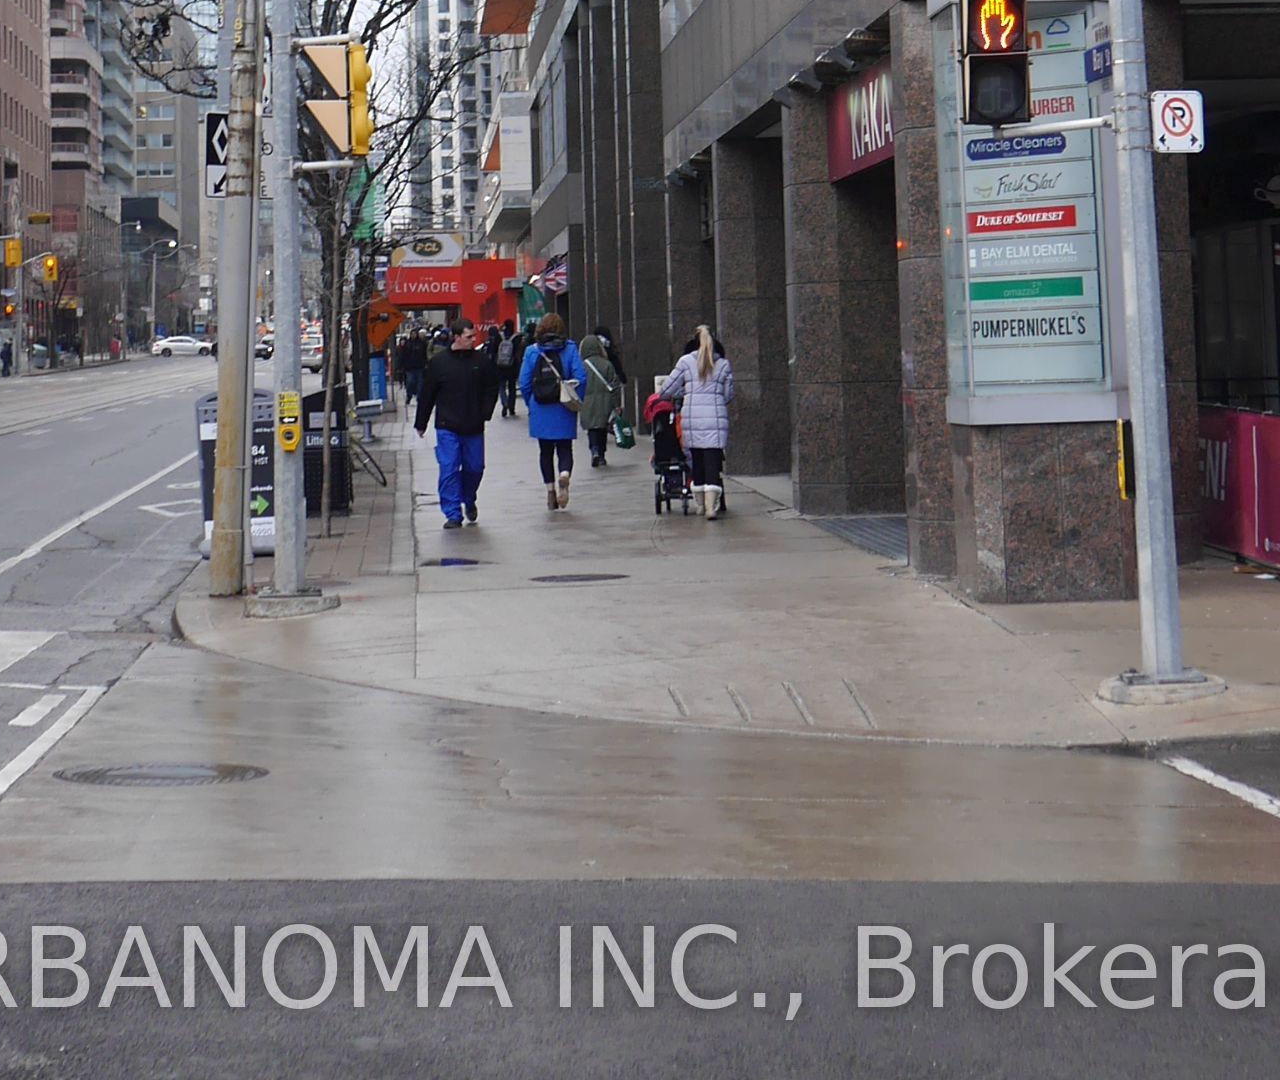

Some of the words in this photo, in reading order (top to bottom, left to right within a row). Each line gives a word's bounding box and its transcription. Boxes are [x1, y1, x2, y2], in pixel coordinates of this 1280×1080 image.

[1031, 95, 1075, 117] URGER
[850, 73, 893, 160] KAKA
[970, 137, 1010, 153] Miracle
[1012, 134, 1062, 151] Cleaners
[976, 213, 1003, 227] DUKE
[1003, 214, 1015, 225] OF
[1015, 210, 1065, 224] SOMERSET
[415, 242, 439, 252] PCL
[980, 247, 1003, 260] BAY
[1006, 245, 1030, 259] ELM
[1032, 243, 1077, 257] DENTAL
[395, 281, 458, 293] LIVMORE
[972, 316, 1086, 338] PUMPERNICKEL'S
[306, 435, 325, 446] Litte
